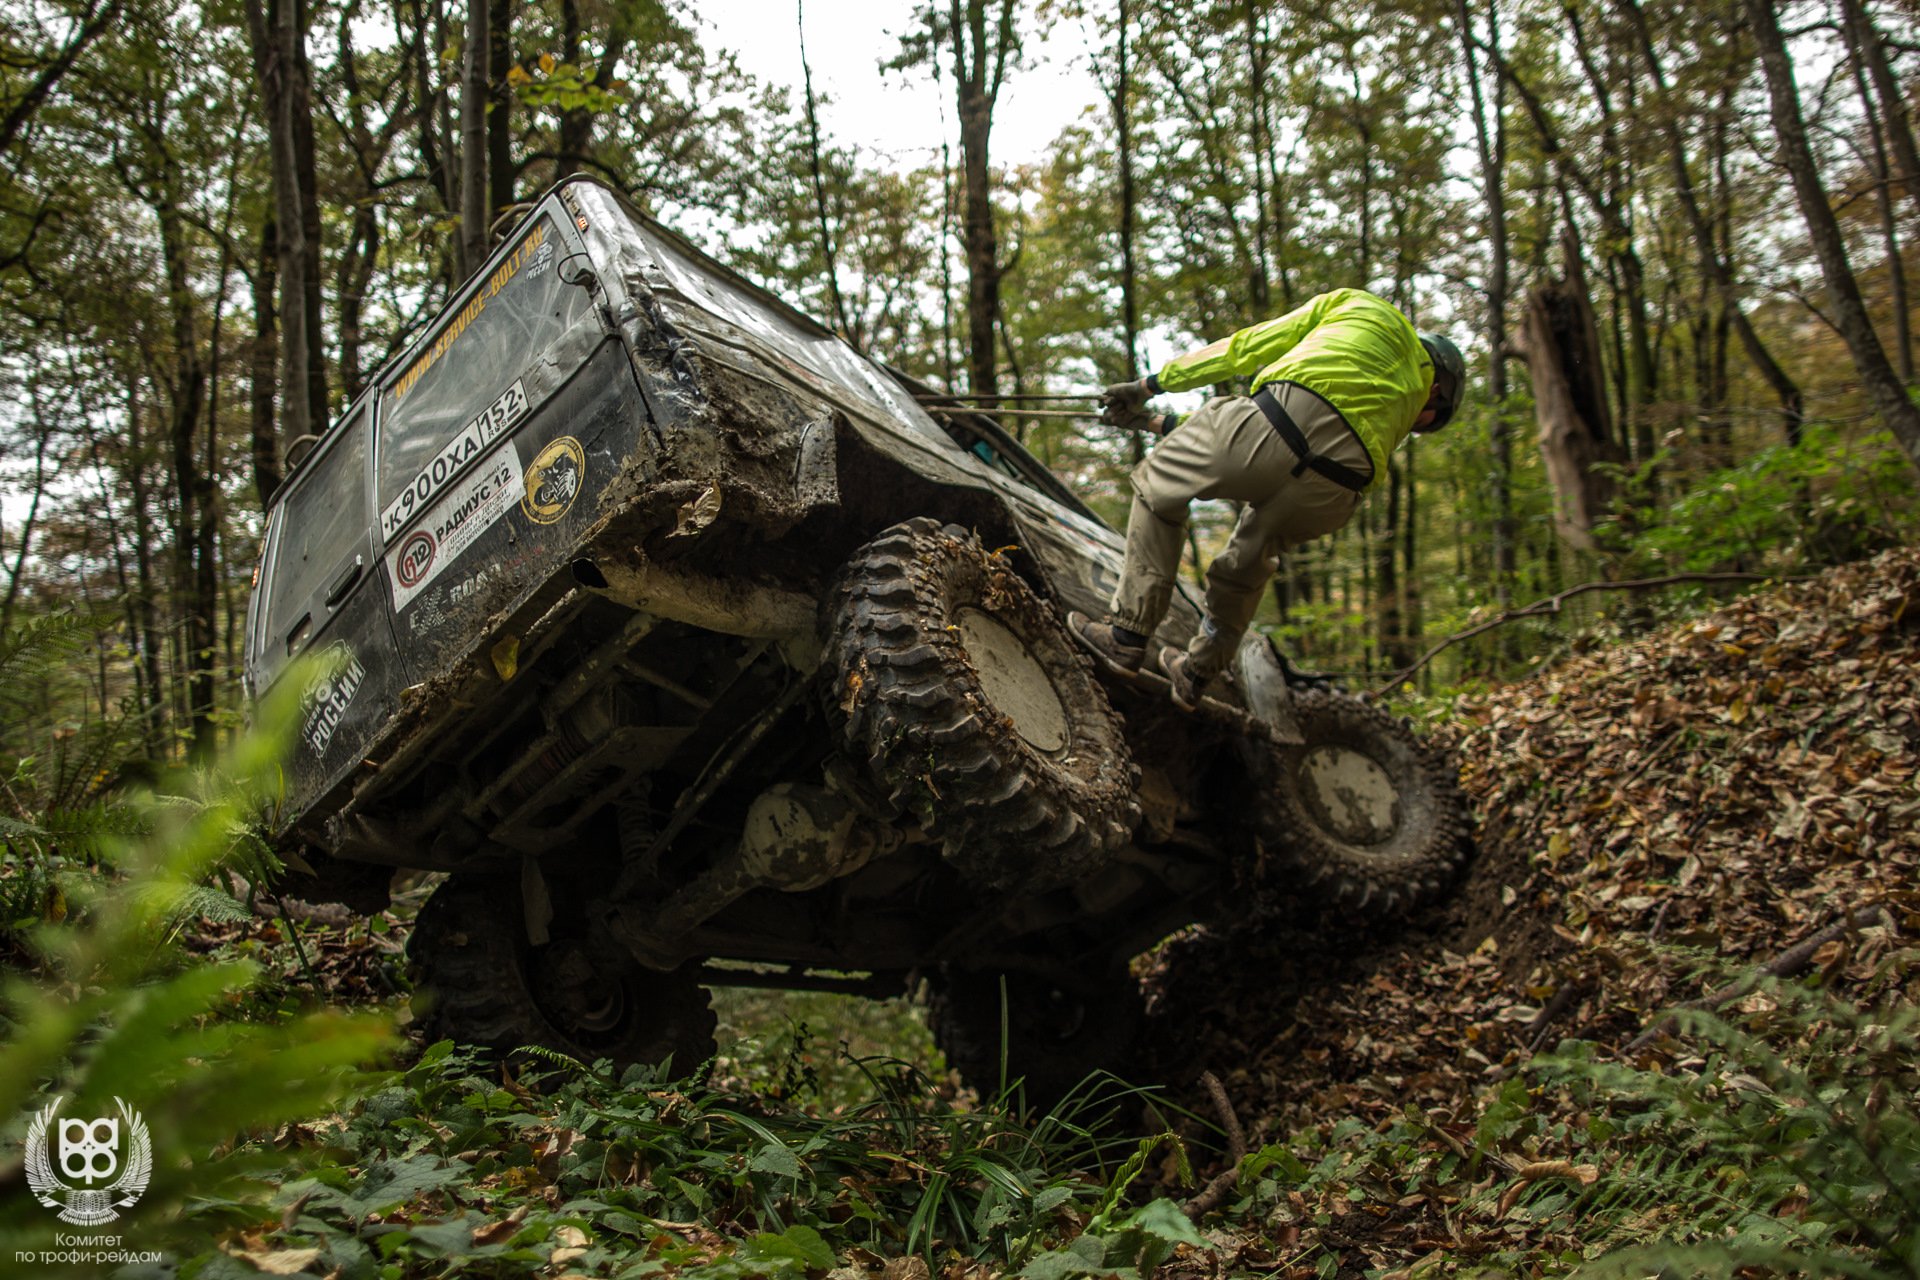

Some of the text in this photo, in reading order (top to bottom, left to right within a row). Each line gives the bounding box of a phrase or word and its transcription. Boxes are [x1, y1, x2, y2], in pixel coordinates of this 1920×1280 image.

[395, 225, 543, 399] WWW.SERVICE-BOLT.RU
[389, 389, 519, 532] К900ХА 152
[488, 418, 508, 440] RUS
[436, 485, 491, 542] РАДИУС
[494, 467, 511, 487] 12
[312, 660, 363, 751] РОССИИ
